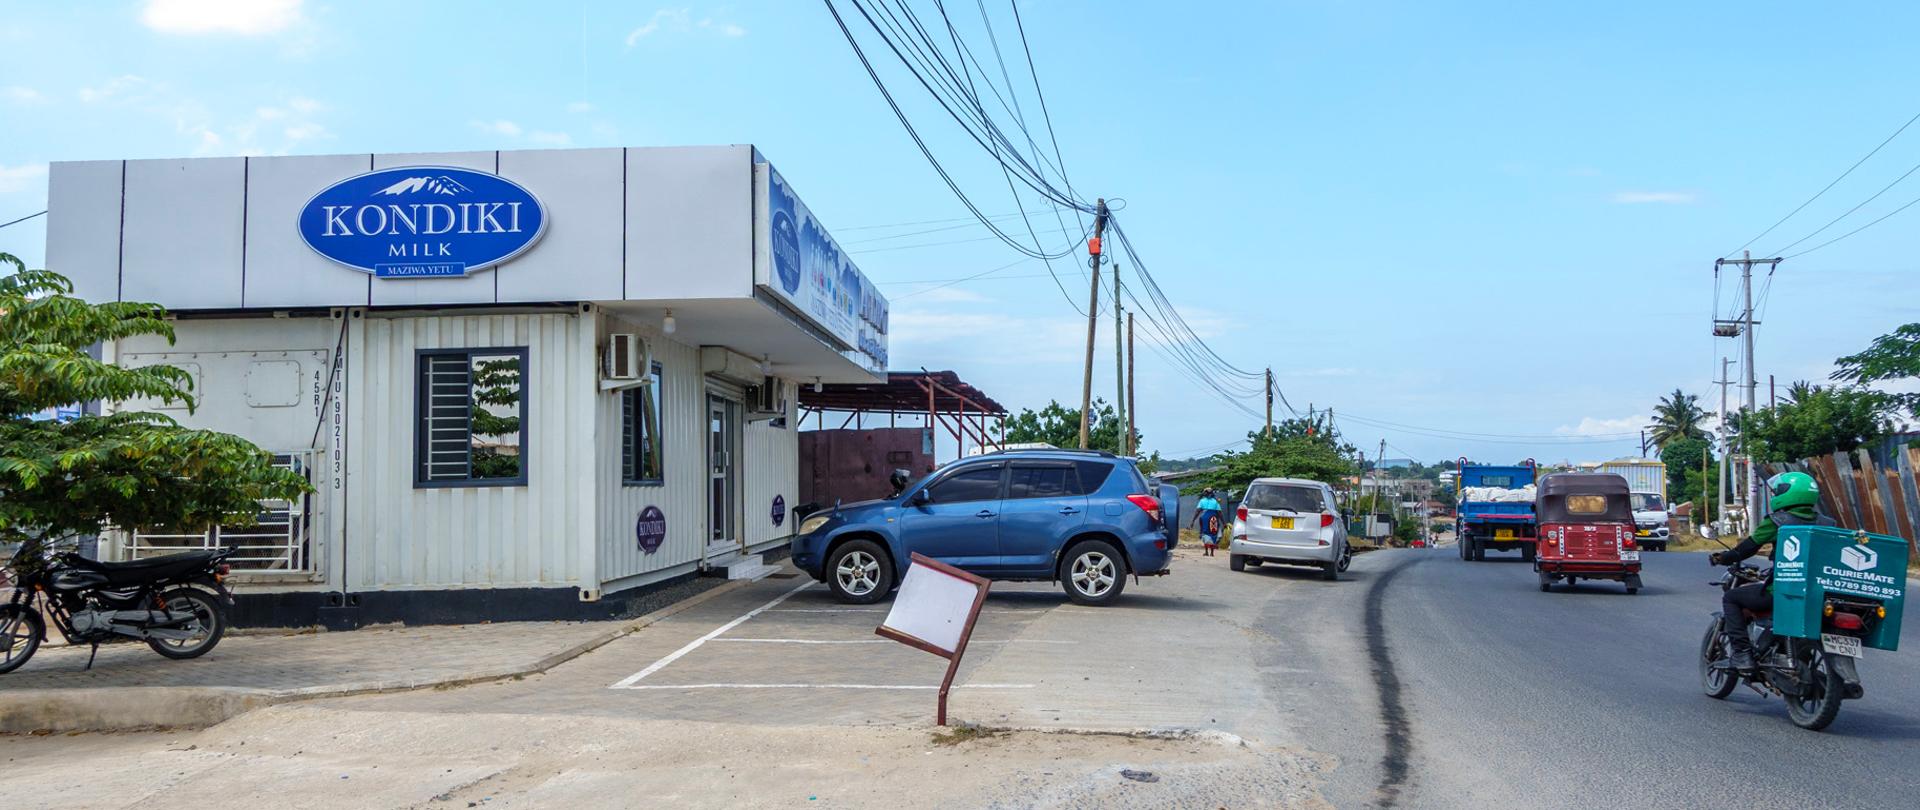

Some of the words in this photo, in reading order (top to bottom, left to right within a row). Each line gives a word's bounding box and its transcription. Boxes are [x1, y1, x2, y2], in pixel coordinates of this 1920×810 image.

[321, 202, 523, 236] KONDIKI
[388, 242, 452, 257] MILK
[387, 265, 426, 276] MAZIWA
[427, 264, 454, 275] YETU
[1815, 576, 1833, 586] Tel:
[1834, 579, 1860, 590] 0789
[1861, 584, 1880, 593] 890
[1881, 587, 1901, 597] 893
